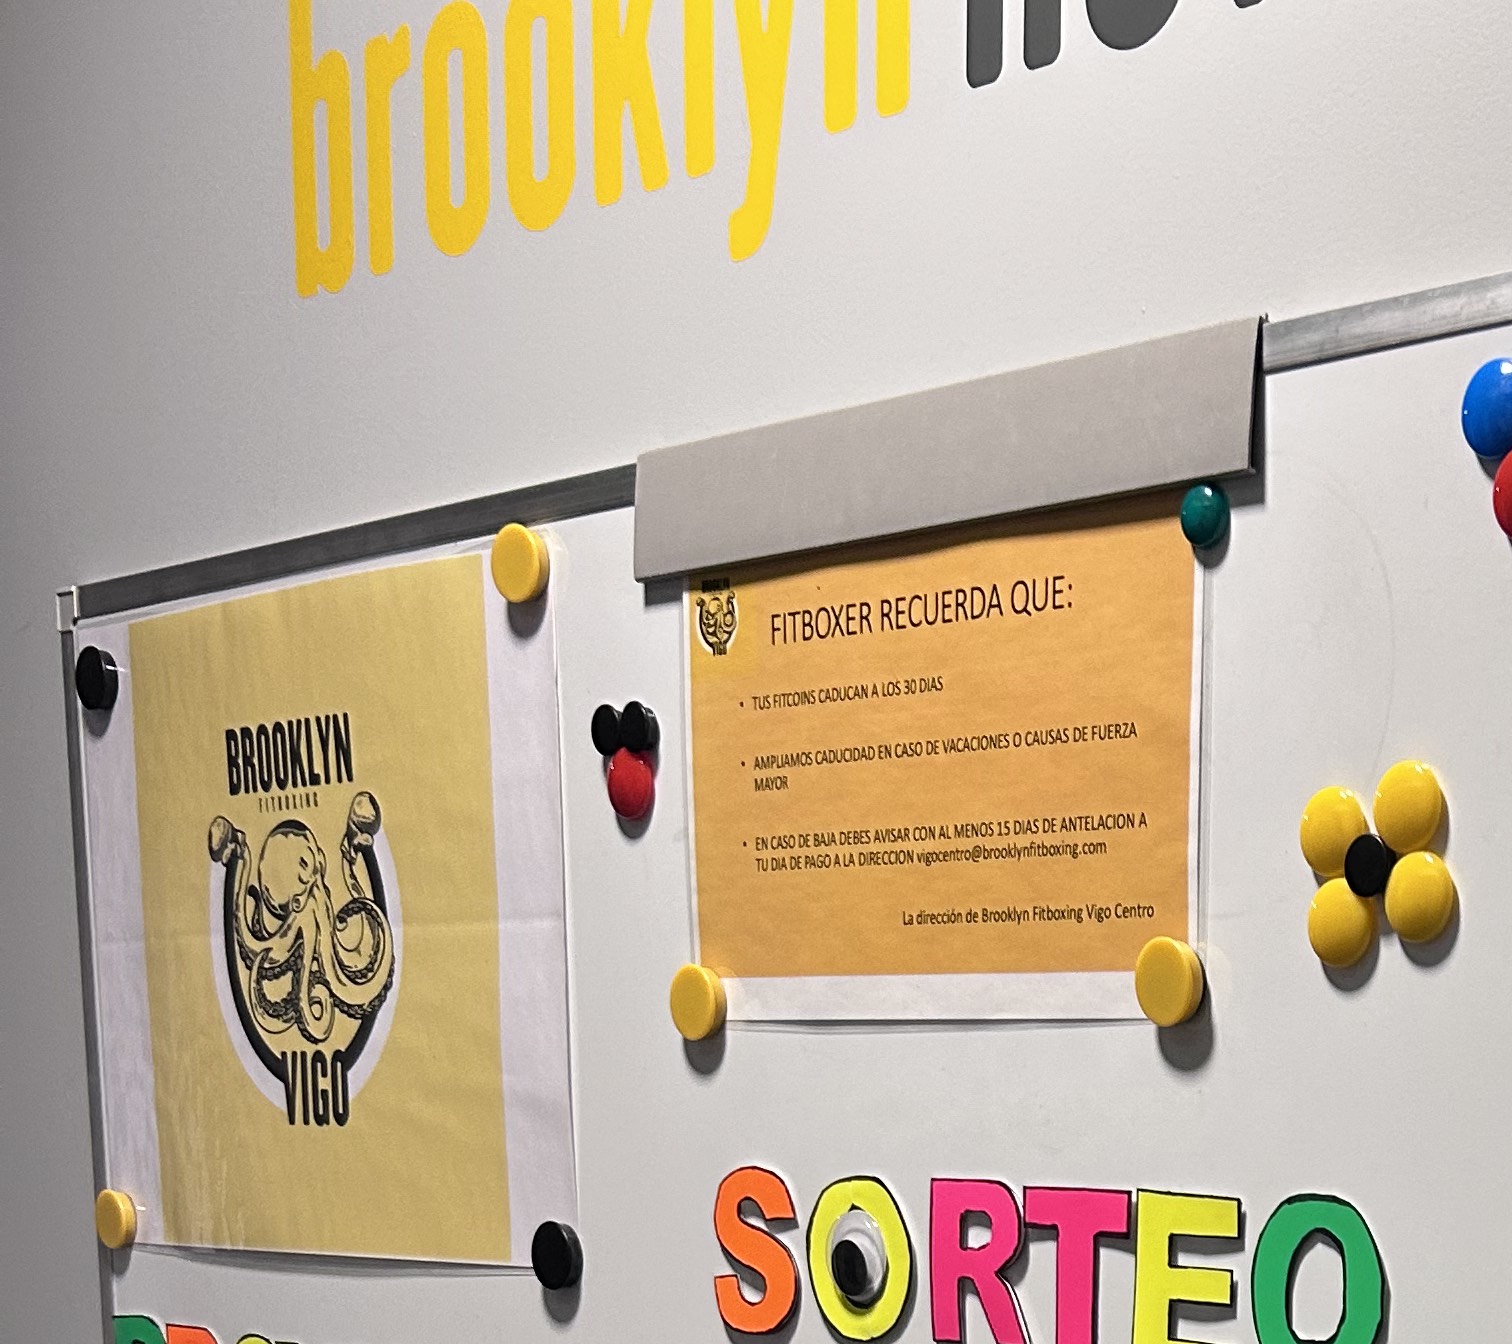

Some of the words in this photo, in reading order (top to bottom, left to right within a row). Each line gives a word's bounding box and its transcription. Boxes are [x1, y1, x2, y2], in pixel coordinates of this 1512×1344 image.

[770, 602, 873, 645] FITBOXER
[880, 584, 1003, 632] RECUERDA
[1011, 575, 1073, 616] QUE:
[752, 695, 771, 711] TUS
[773, 690, 816, 708] FITCOINS
[818, 684, 869, 704] CADUCAN
[871, 686, 879, 699] A
[882, 681, 901, 697] LOS
[904, 680, 917, 695] 30
[919, 676, 944, 694] DIAS
[226, 712, 353, 796] BROOKLYN
[754, 751, 813, 771] AMPLIAMOS
[815, 746, 875, 766] CADUCIDAD
[878, 744, 892, 759] EN
[894, 742, 923, 758] CASO
[925, 740, 940, 756] DE
[943, 733, 1009, 754] VACACIONES
[1013, 732, 1021, 748] O
[1025, 728, 1069, 747] CAUSAS
[1073, 726, 1088, 743] DE
[1091, 722, 1137, 742] FUERZA
[754, 775, 789, 792] MAYOR
[902, 911, 913, 925] La
[916, 909, 963, 925] dirección
[966, 908, 978, 923] de
[982, 906, 1029, 925] Brooklyn
[1033, 904, 1083, 923] Fitboxing
[1086, 904, 1111, 923] Vigo
[1114, 903, 1154, 919] Centro
[281, 1049, 349, 1127] VIGO
